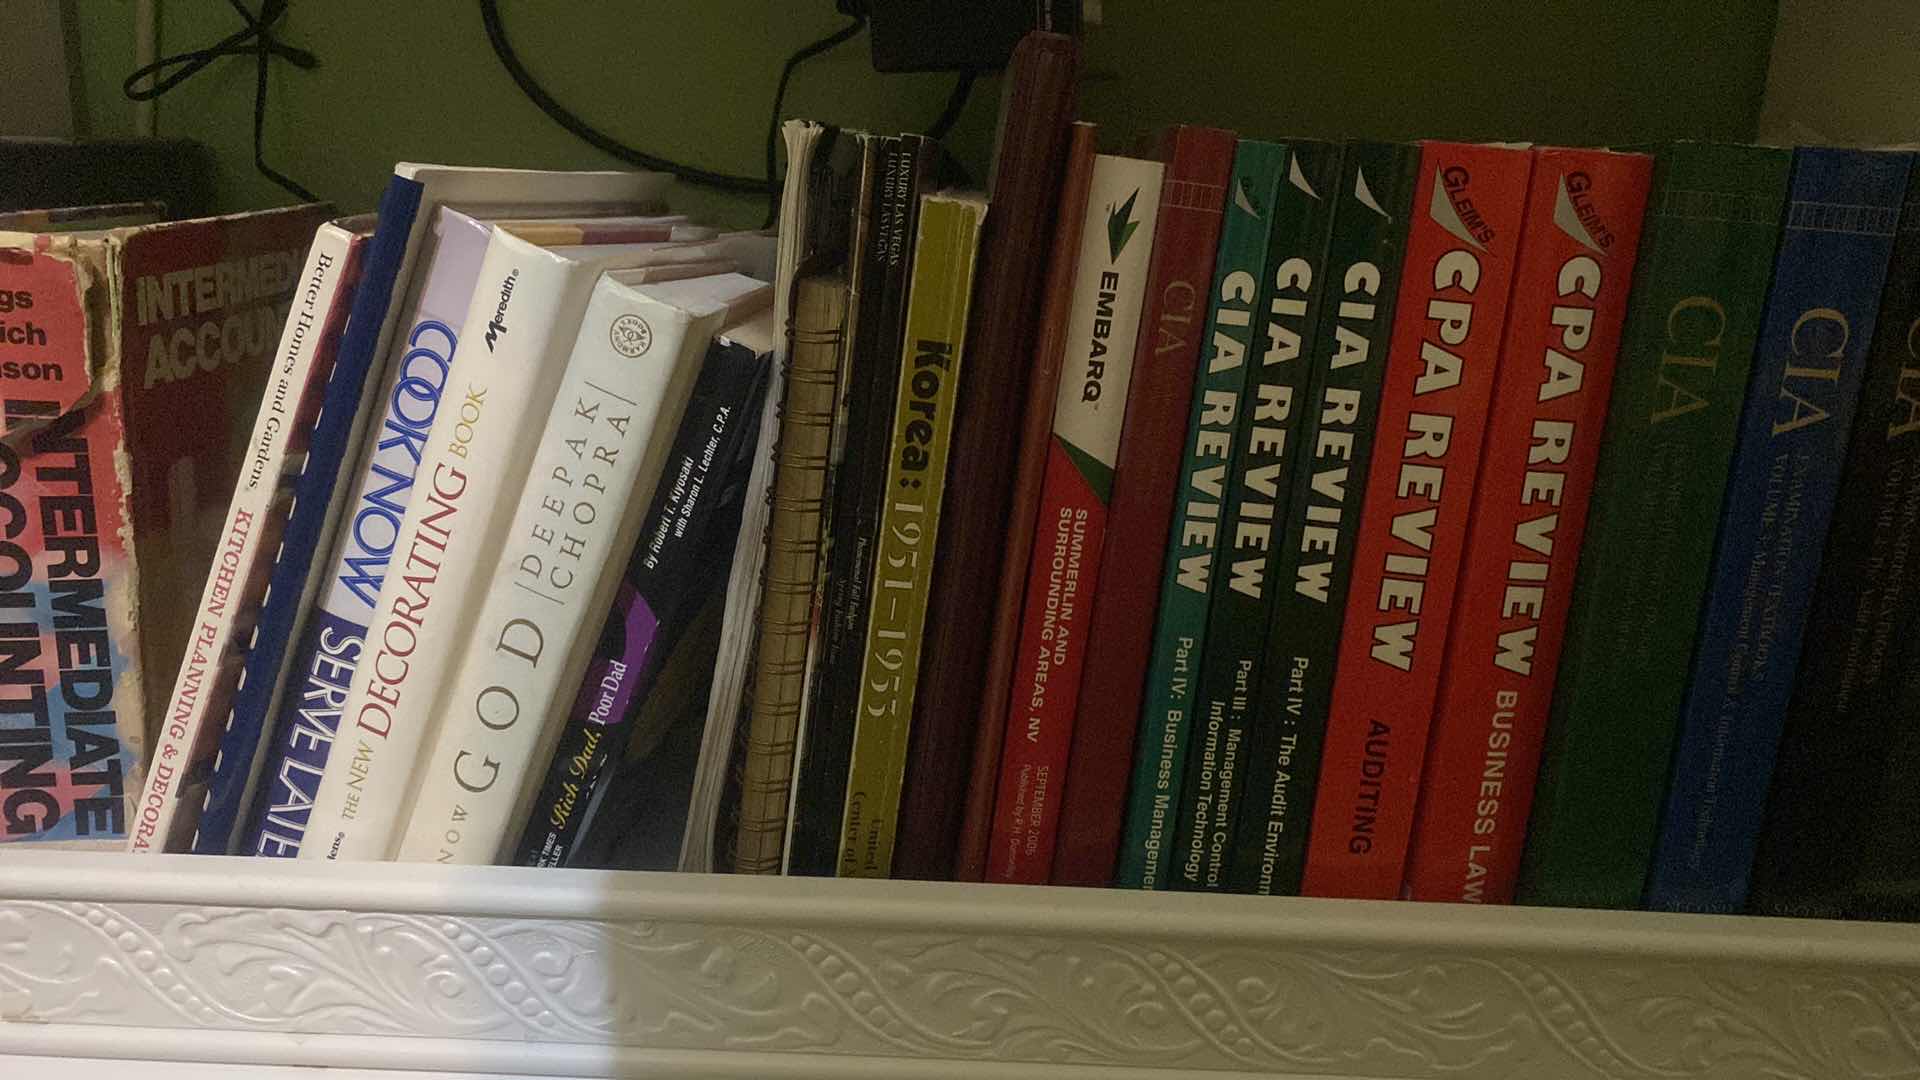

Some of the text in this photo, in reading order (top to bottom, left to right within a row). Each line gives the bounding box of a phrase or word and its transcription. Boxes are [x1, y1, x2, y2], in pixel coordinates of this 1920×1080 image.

[883, 152, 898, 199] LUXURY
[889, 152, 911, 265] LUXURY LAS VEGAS
[304, 251, 333, 312] Better
[483, 275, 519, 353] Meredith
[1082, 271, 1120, 403] EMBARQ
[1154, 280, 1197, 356] CIA
[0, 361, 63, 381] son
[271, 378, 289, 414] and
[283, 310, 314, 377] Homes
[1649, 294, 1727, 424] CIA
[1771, 306, 1851, 438] CIA
[338, 319, 459, 610] COOK NOW
[700, 432, 719, 473] Lechter,
[713, 404, 731, 434] C.P.A.
[1175, 270, 1257, 595] CIA REVIEW
[1228, 257, 1313, 600] CIA REVIEW
[1294, 261, 1382, 604] CIA REVIEW
[1370, 249, 1481, 672] CPA REVIEW
[1493, 254, 1602, 677] CPA REVIEW
[519, 397, 601, 579] DEEPAK
[551, 413, 632, 589] CHOPRA
[645, 549, 657, 571] by
[652, 517, 673, 559] Robert
[672, 456, 694, 505] Kiyosaki
[674, 517, 688, 539] with
[680, 480, 701, 518] Sharon
[867, 339, 952, 718] Korea: 1951-1953
[208, 508, 253, 619] KITCHEN
[342, 384, 488, 821] THE NEW DECORATING BOOK
[1053, 508, 1088, 666] SUMMERLIN AND
[169, 622, 218, 739] PLANNING
[1026, 507, 1072, 744] SURROUNDING AREAS, NV
[1174, 637, 1193, 671] Part
[1234, 660, 1252, 693] Part
[1288, 656, 1310, 693] Part
[289, 626, 366, 751] SERVE
[453, 617, 545, 793] GOD
[162, 744, 178, 760] &
[551, 659, 628, 831] Rich Dad, Poor Dad
[1029, 765, 1049, 829] SEPTEMBER
[1157, 709, 1182, 790] Business
[1184, 700, 1226, 882] Information Technology
[1219, 728, 1242, 828] Management
[1269, 770, 1291, 817] Audit
[1277, 733, 1298, 766] The
[1350, 718, 1391, 856] AUDITING
[1462, 690, 1518, 903] BUSINESS LAW
[133, 763, 174, 853] DECORA
[541, 832, 557, 856] TIMES
[1206, 831, 1227, 888] Control
